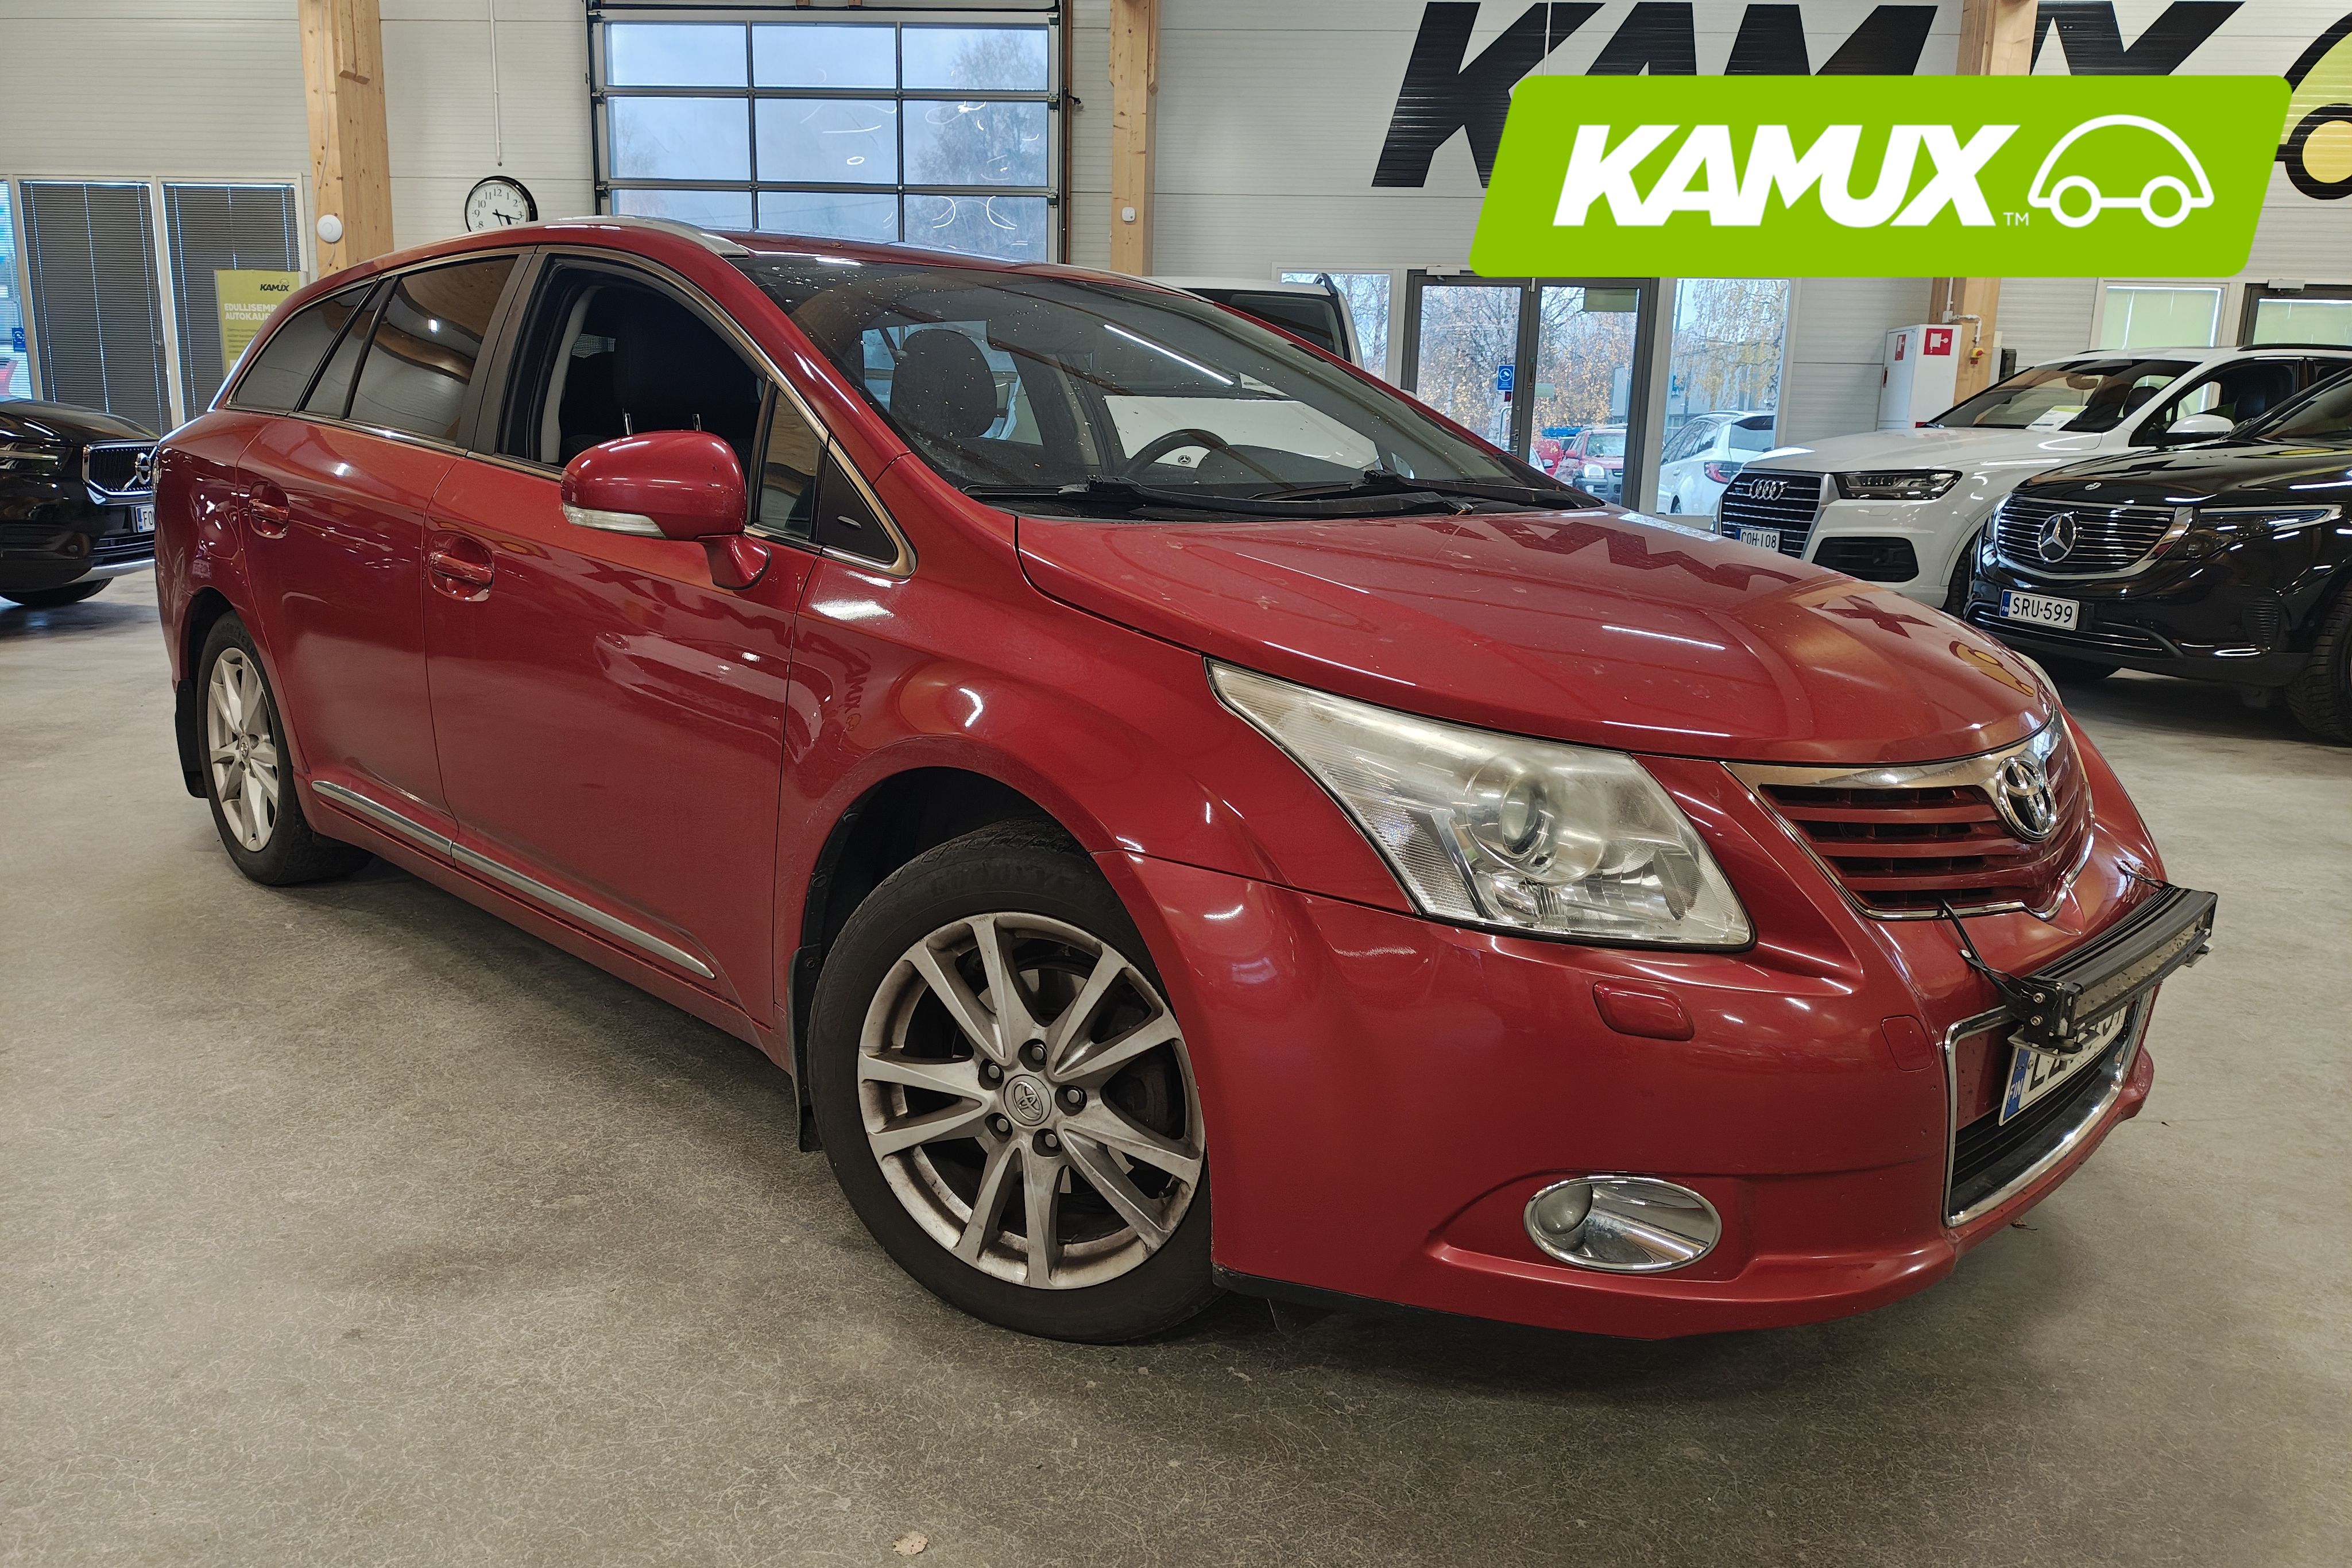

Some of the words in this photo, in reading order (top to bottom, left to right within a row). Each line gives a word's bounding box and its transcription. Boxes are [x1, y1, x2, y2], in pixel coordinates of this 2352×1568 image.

[485, 191, 492, 200] 11
[493, 188, 502, 197] 12
[506, 192, 510, 200] 1
[478, 199, 487, 208] 10
[513, 199, 519, 207] 2
[474, 209, 481, 218] 9
[517, 211, 525, 219] 3
[478, 220, 484, 229] 8
[260, 283, 290, 292] KAMUX
[224, 303, 277, 312] EDULLISEMP
[143, 510, 154, 526] FO
[2012, 597, 2073, 623] SRU-599
[2007, 1078, 2024, 1104] FIN
